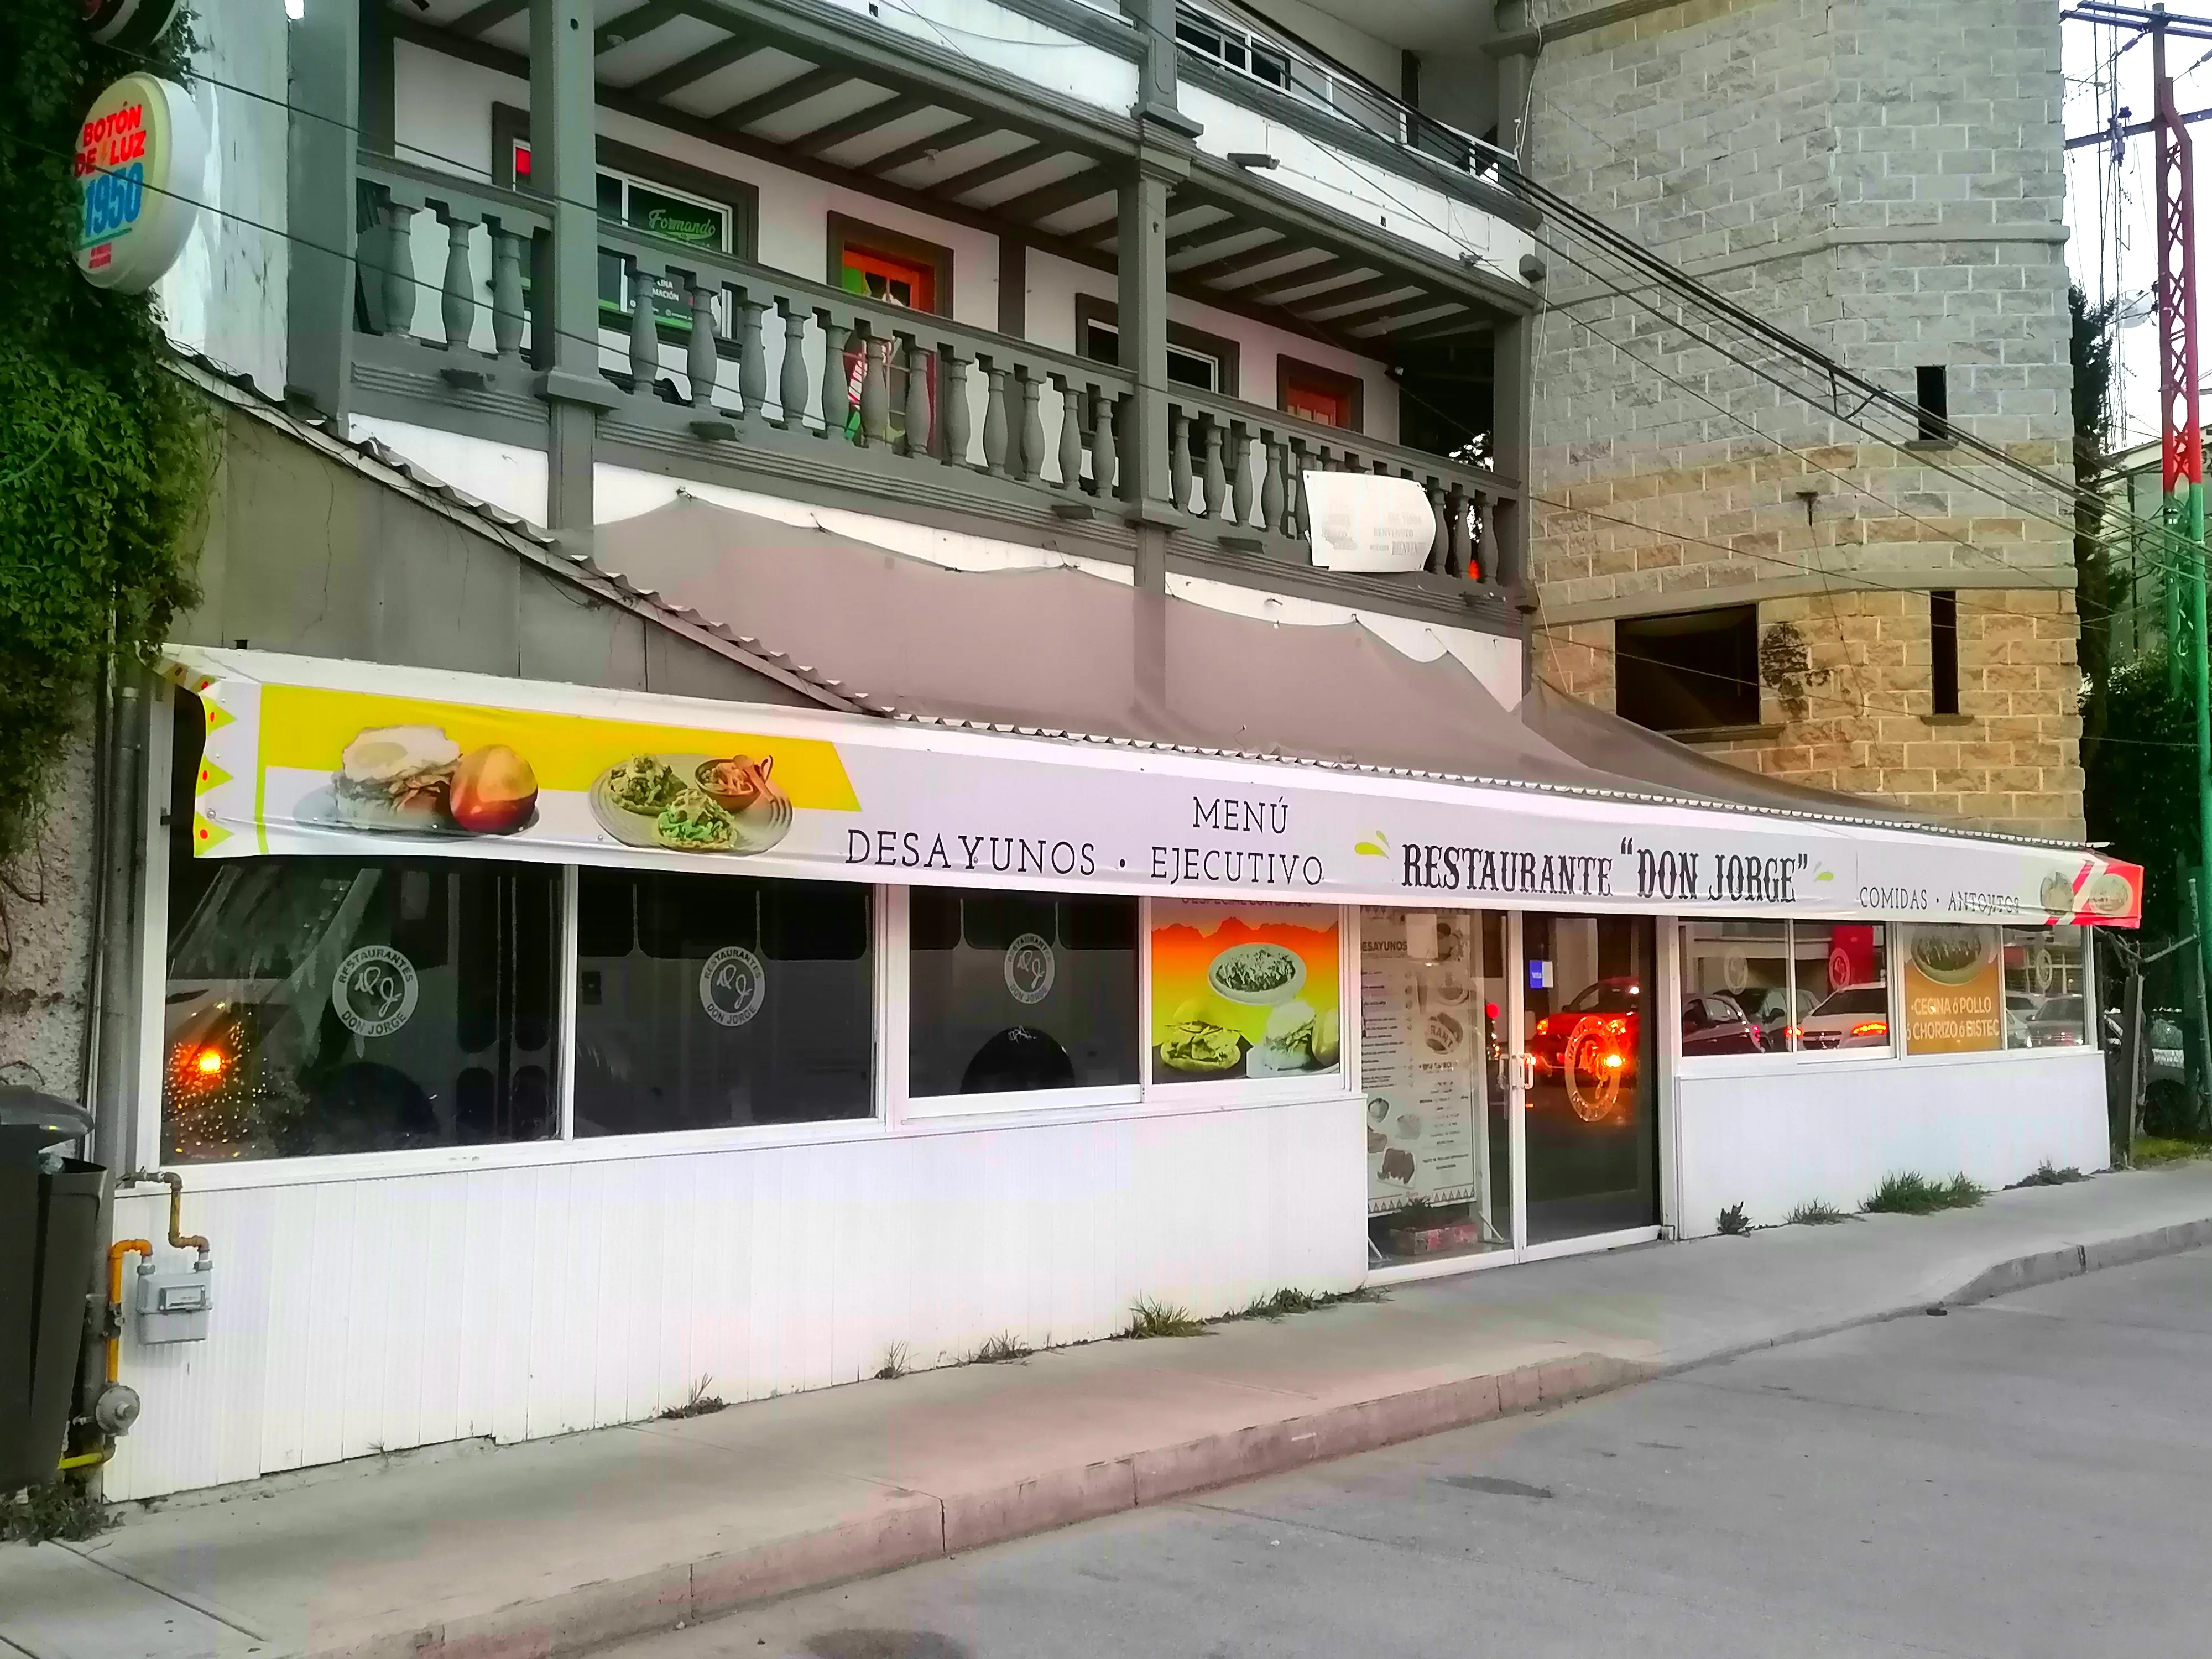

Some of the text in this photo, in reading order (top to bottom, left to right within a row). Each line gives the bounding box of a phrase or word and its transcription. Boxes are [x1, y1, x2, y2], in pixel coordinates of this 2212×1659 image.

[74, 130, 147, 178] DE LUZ
[84, 162, 144, 238] 1950
[648, 209, 716, 235] Formando
[1192, 796, 1288, 834] MENÚ
[845, 828, 1323, 885] DESAYUNOS EJECUTIVO
[1401, 843, 1614, 897] RESTAURANTE
[1859, 886, 2020, 916] COMIDAS ANTOJITOS
[706, 1003, 725, 1022] DON
[1959, 996, 1992, 1014] POLLO
[341, 1010, 406, 1035] DON JORGE
[1912, 1021, 1958, 1040] CHORIZO
[1966, 1018, 2000, 1037] BISTEC
